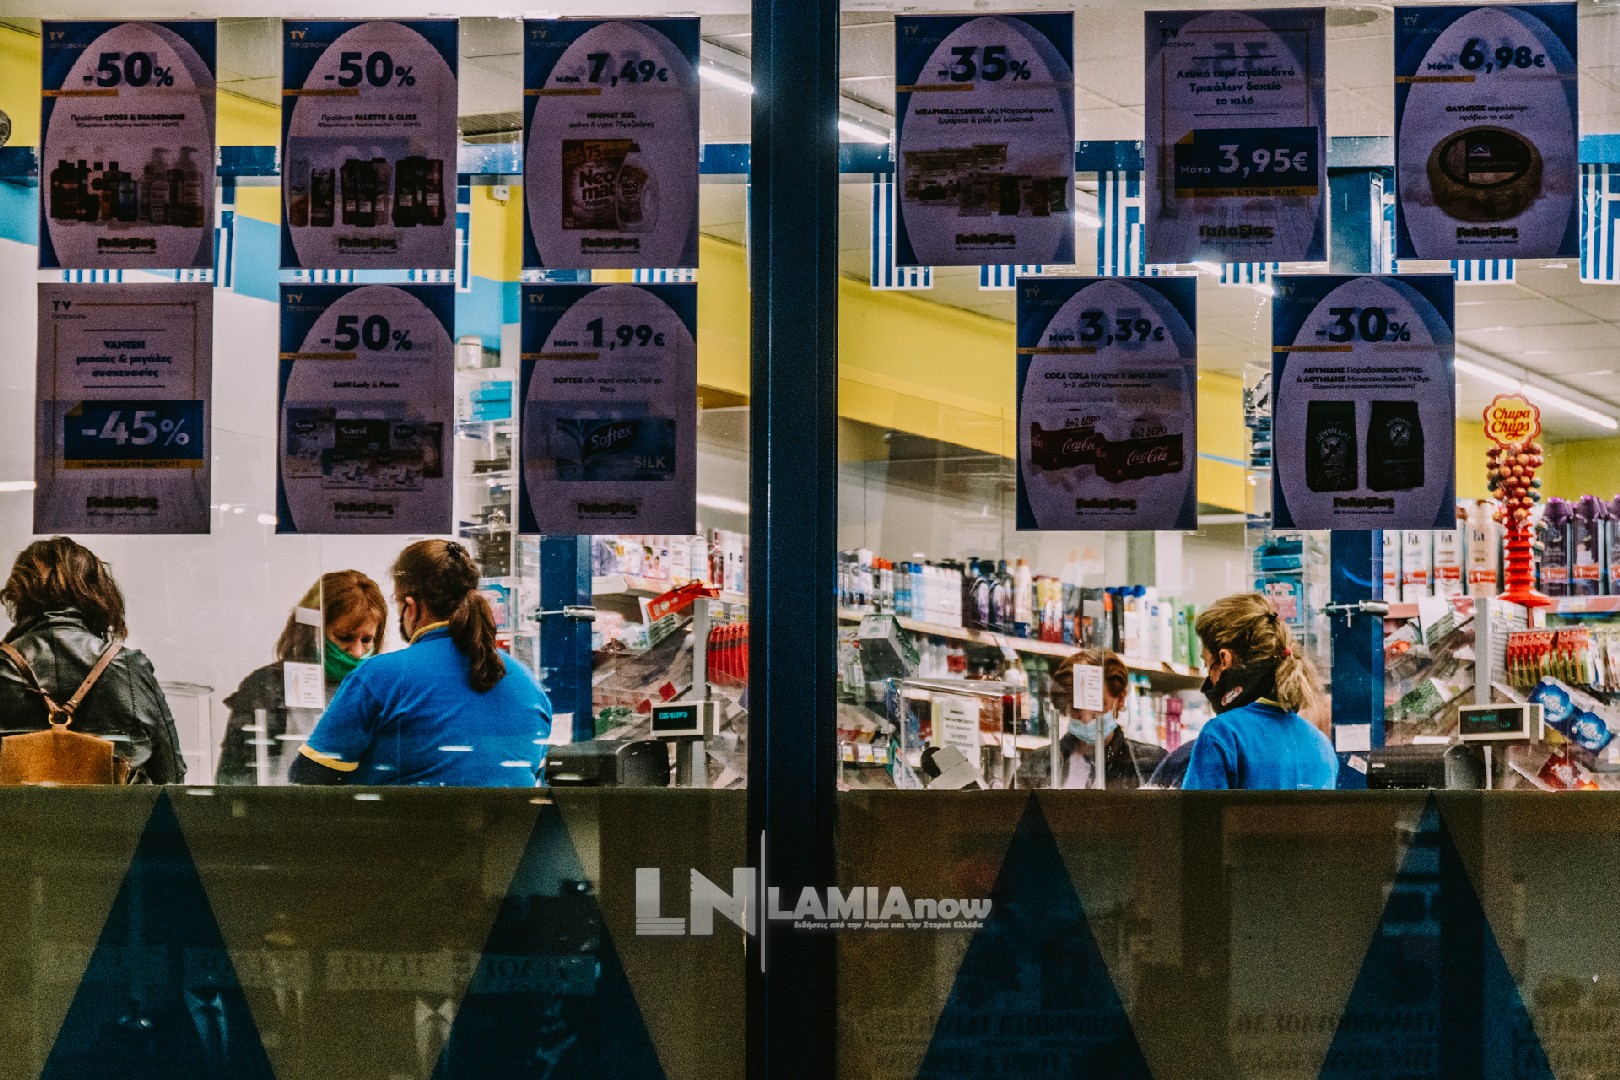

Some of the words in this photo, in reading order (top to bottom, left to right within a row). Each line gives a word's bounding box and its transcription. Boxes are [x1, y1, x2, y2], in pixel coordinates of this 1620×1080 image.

[83, 51, 174, 88] -50%
[324, 50, 417, 88] -50%
[586, 52, 669, 88] 7,49€
[937, 44, 1032, 83] -35%
[1458, 37, 1546, 75] 6,98€
[1188, 81, 1244, 95] Τρικάλων
[1230, 95, 1255, 106] κιλό
[1218, 143, 1308, 179] 3,95€
[52, 300, 72, 312] TV
[320, 314, 415, 351] -50%
[585, 317, 666, 352] 1,99€
[1079, 310, 1166, 348] 3,39€
[1315, 306, 1412, 343] -30%
[103, 340, 147, 350] VANISH
[118, 353, 128, 364] &
[1044, 372, 1067, 380] COCA
[1068, 372, 1091, 380] COLA
[81, 410, 191, 447] -45%
[1491, 420, 1531, 440] Chups
[1492, 407, 1531, 422] Chupa
[590, 424, 633, 450] Softex
[633, 455, 667, 469] SILK
